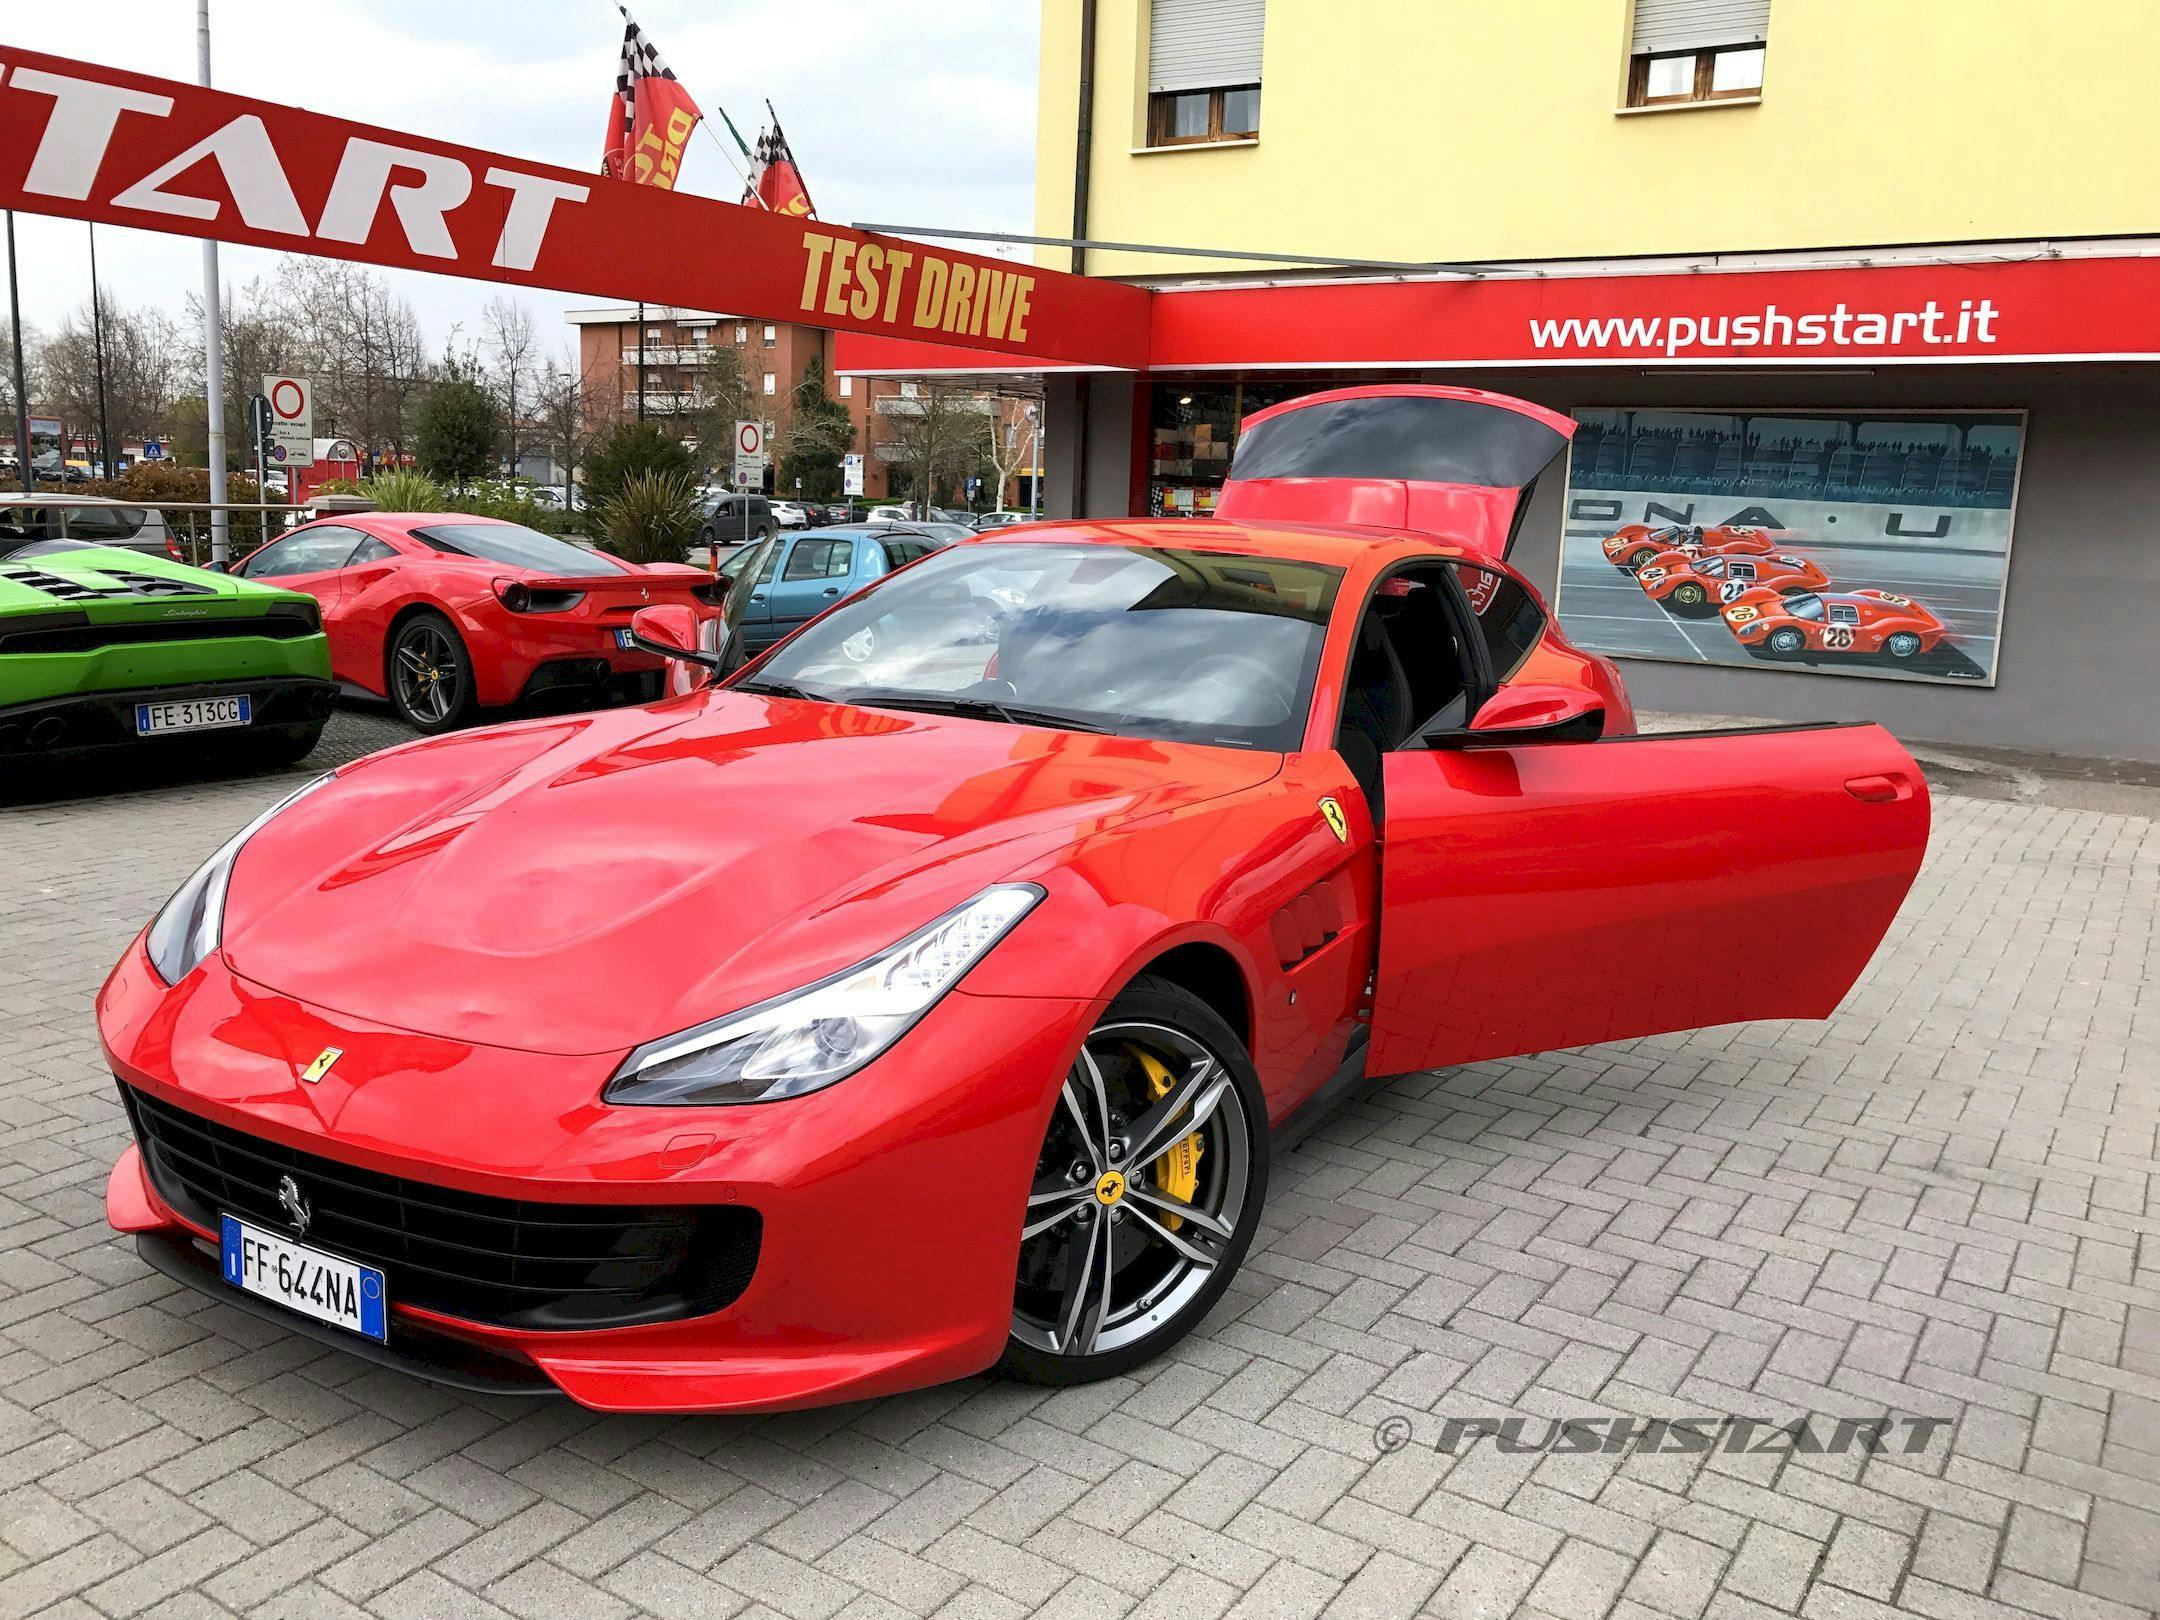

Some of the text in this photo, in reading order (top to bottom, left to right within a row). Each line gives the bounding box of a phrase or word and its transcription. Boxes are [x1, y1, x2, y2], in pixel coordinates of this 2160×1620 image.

[0, 63, 591, 272] TART
[800, 231, 1036, 344] TEST DRIVE
[1528, 299, 1999, 357] www.pushstart.it
[152, 705, 176, 728] FE
[182, 700, 238, 724] 313CG
[243, 1236, 270, 1282] FF
[278, 1252, 358, 1319] 644NA
